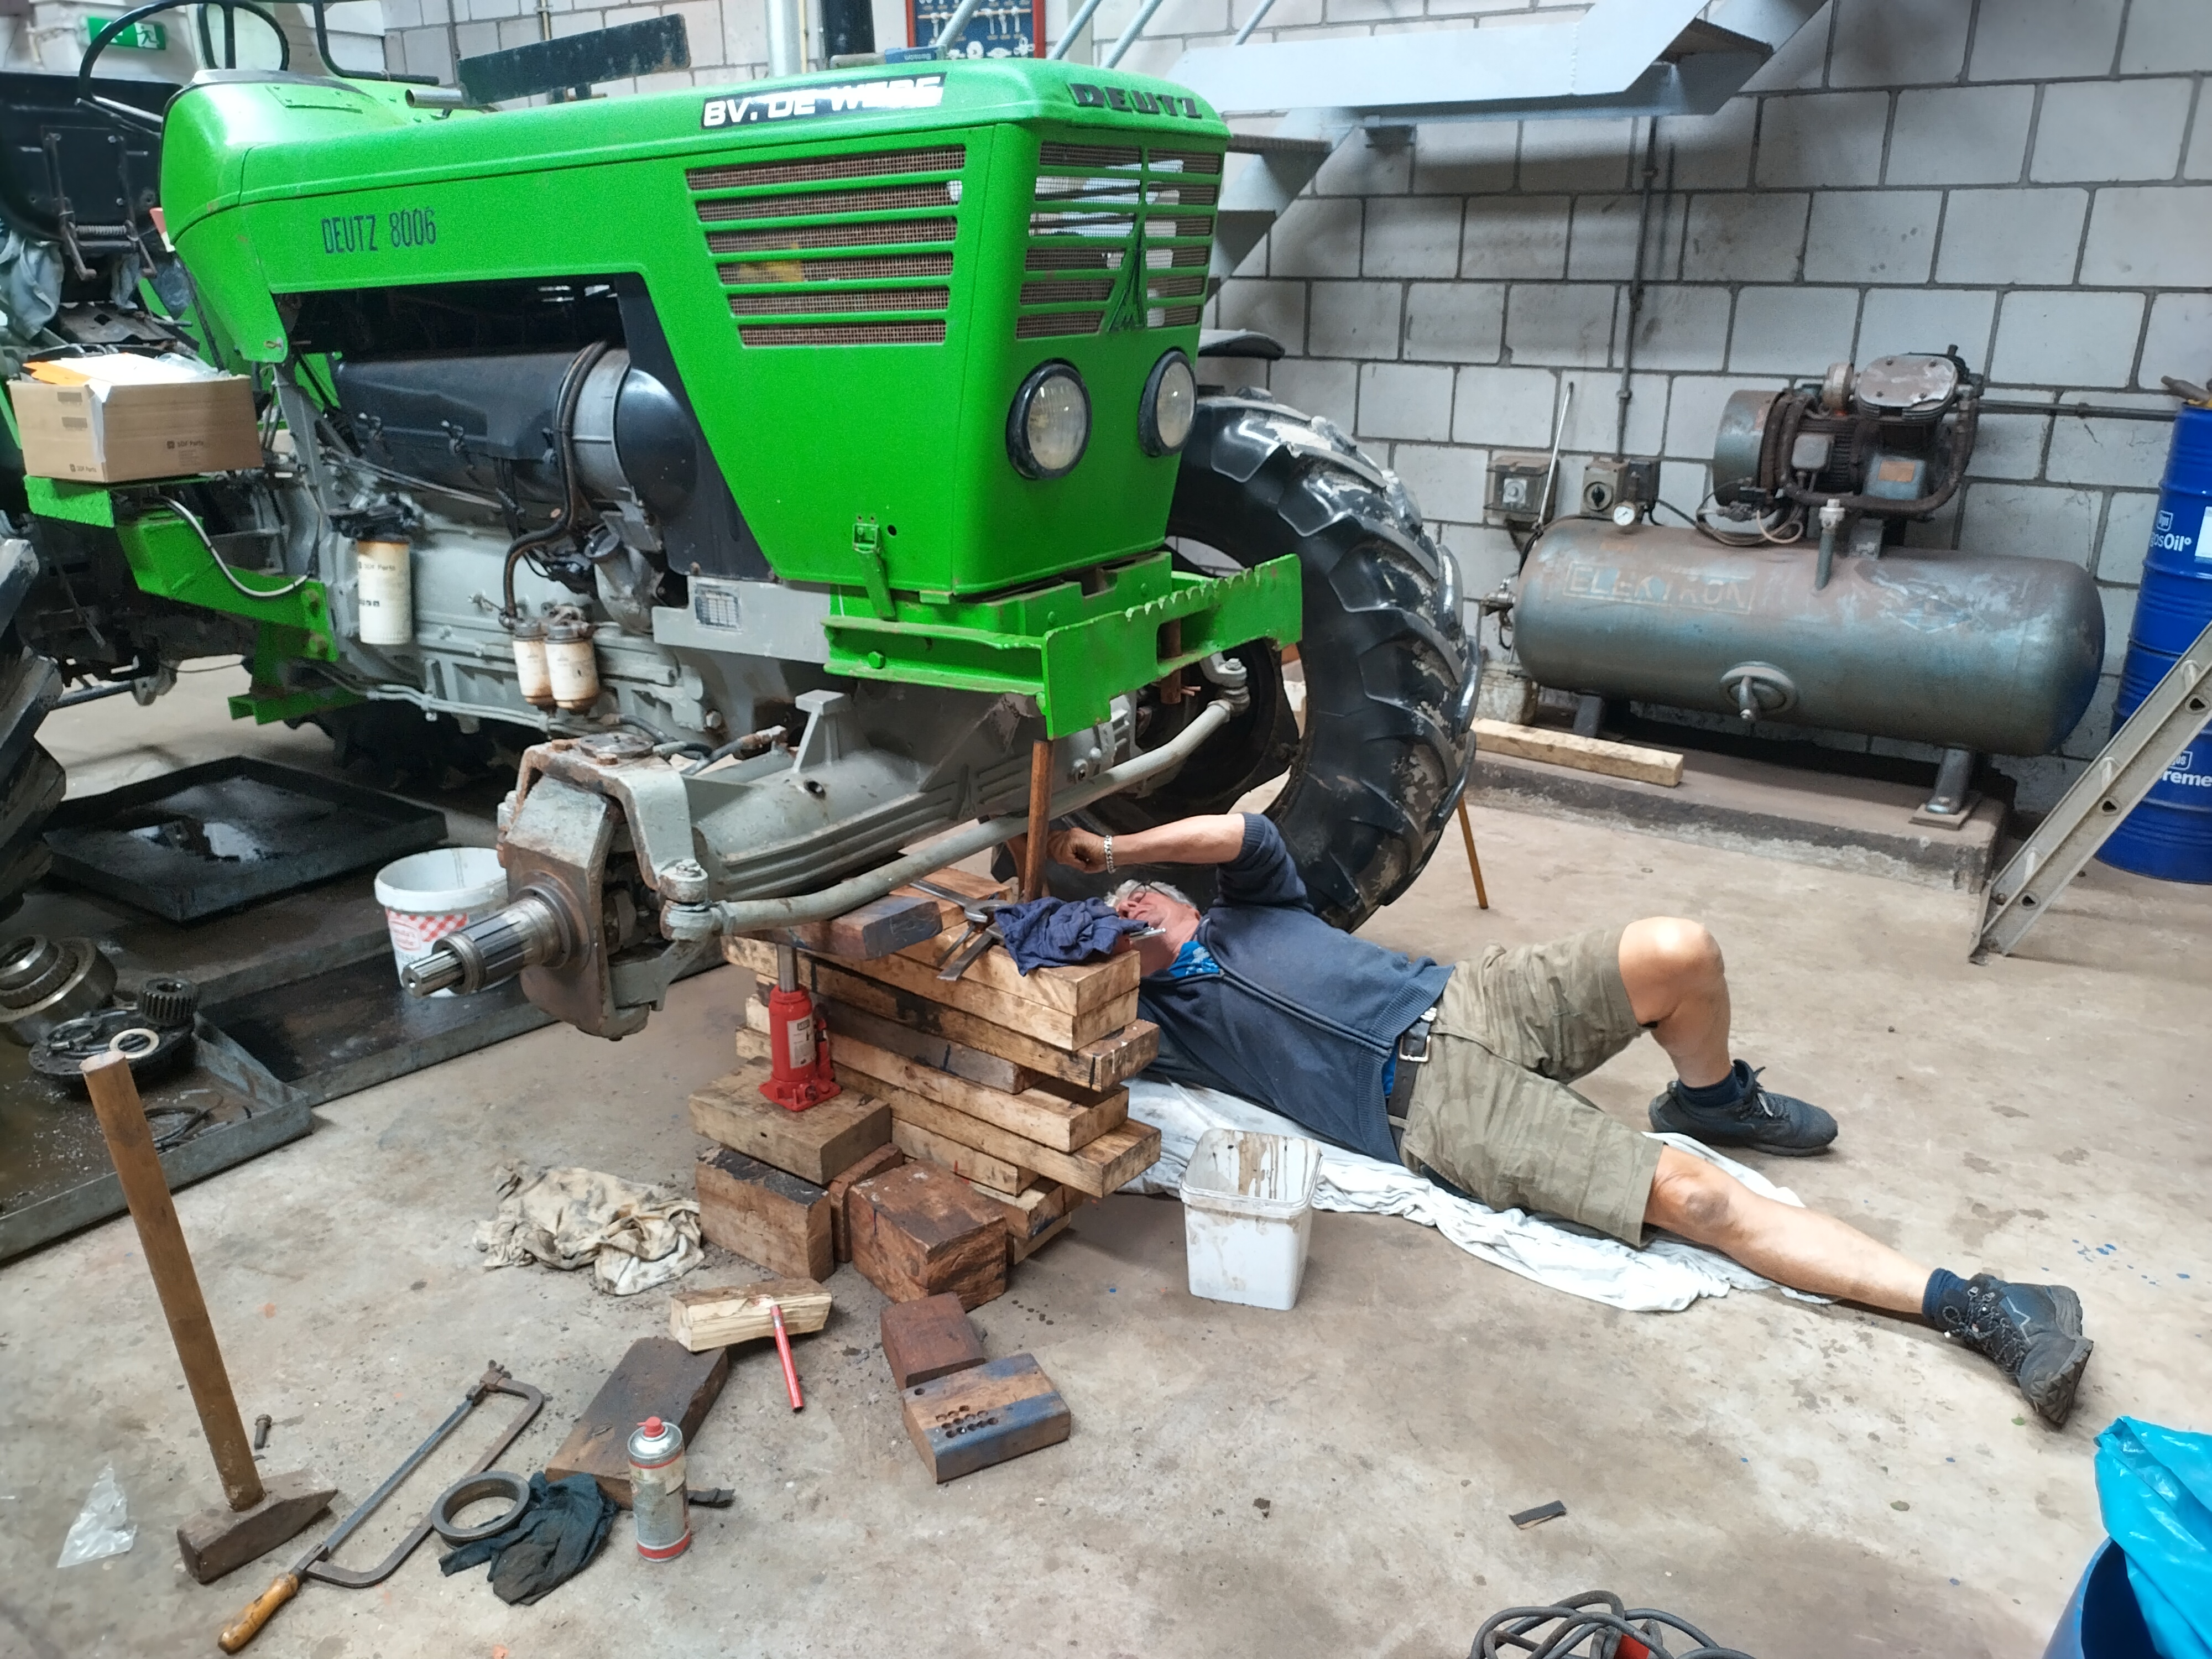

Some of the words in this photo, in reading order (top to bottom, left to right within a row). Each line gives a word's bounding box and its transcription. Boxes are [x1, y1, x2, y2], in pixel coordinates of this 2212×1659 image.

[703, 99, 758, 127] BV.
[766, 90, 818, 119] DE
[1068, 82, 1203, 119] DEUTZ
[321, 214, 378, 254] DEUTZ
[389, 206, 436, 248] 8006
[2159, 770, 2212, 787] reme
